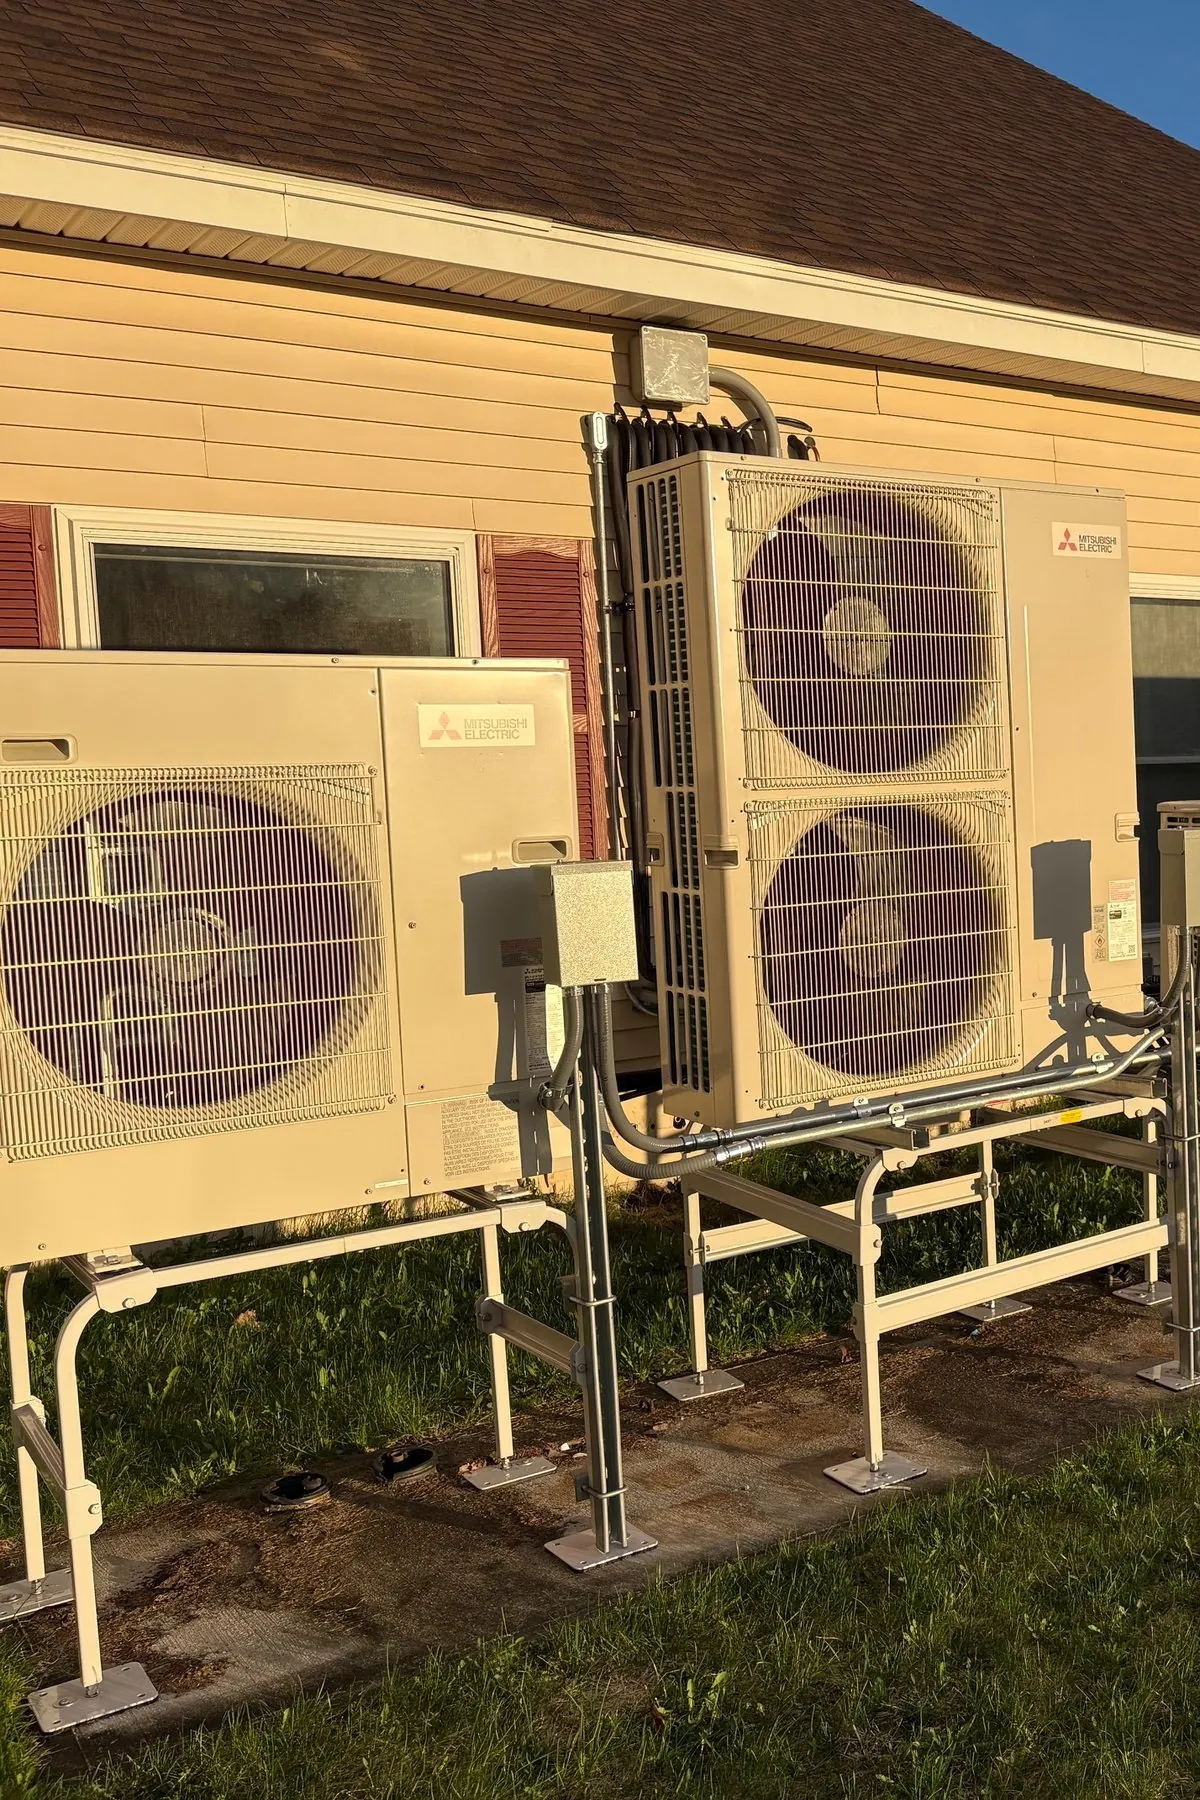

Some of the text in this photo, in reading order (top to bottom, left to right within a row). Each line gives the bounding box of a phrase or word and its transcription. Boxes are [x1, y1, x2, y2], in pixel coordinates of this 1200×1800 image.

[1079, 534, 1117, 545] MITSUBISHI
[1079, 544, 1113, 553] ELECTRIC
[464, 718, 528, 729] MITSUBISHI
[464, 729, 520, 740] ELECTRIC
